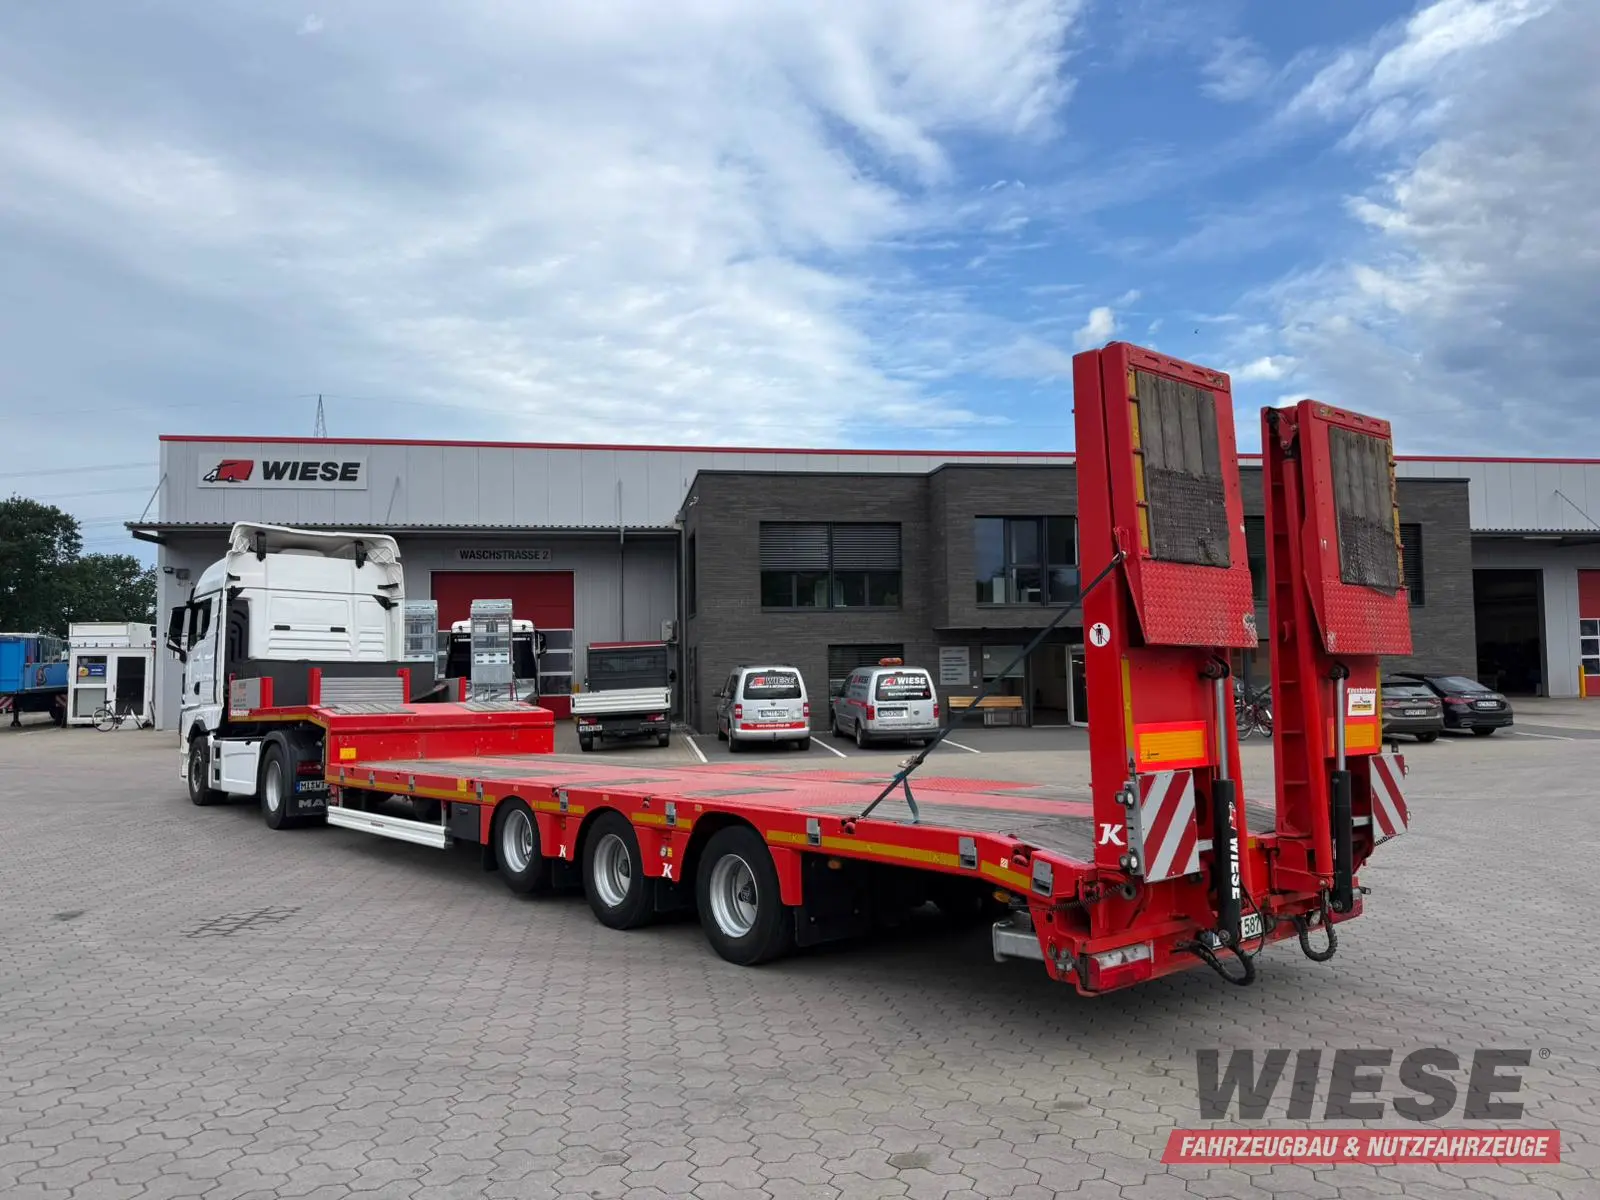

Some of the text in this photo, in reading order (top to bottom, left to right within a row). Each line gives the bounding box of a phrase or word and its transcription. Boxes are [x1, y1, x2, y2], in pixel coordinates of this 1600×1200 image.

[262, 461, 361, 482] WIESE
[459, 549, 548, 560] WASCHSTRASSE 2
[766, 676, 796, 685] WIESE
[897, 676, 926, 685] WIESE
[298, 799, 325, 807] MA
[1229, 837, 1241, 899] WIESE
[1243, 915, 1262, 936] 587
